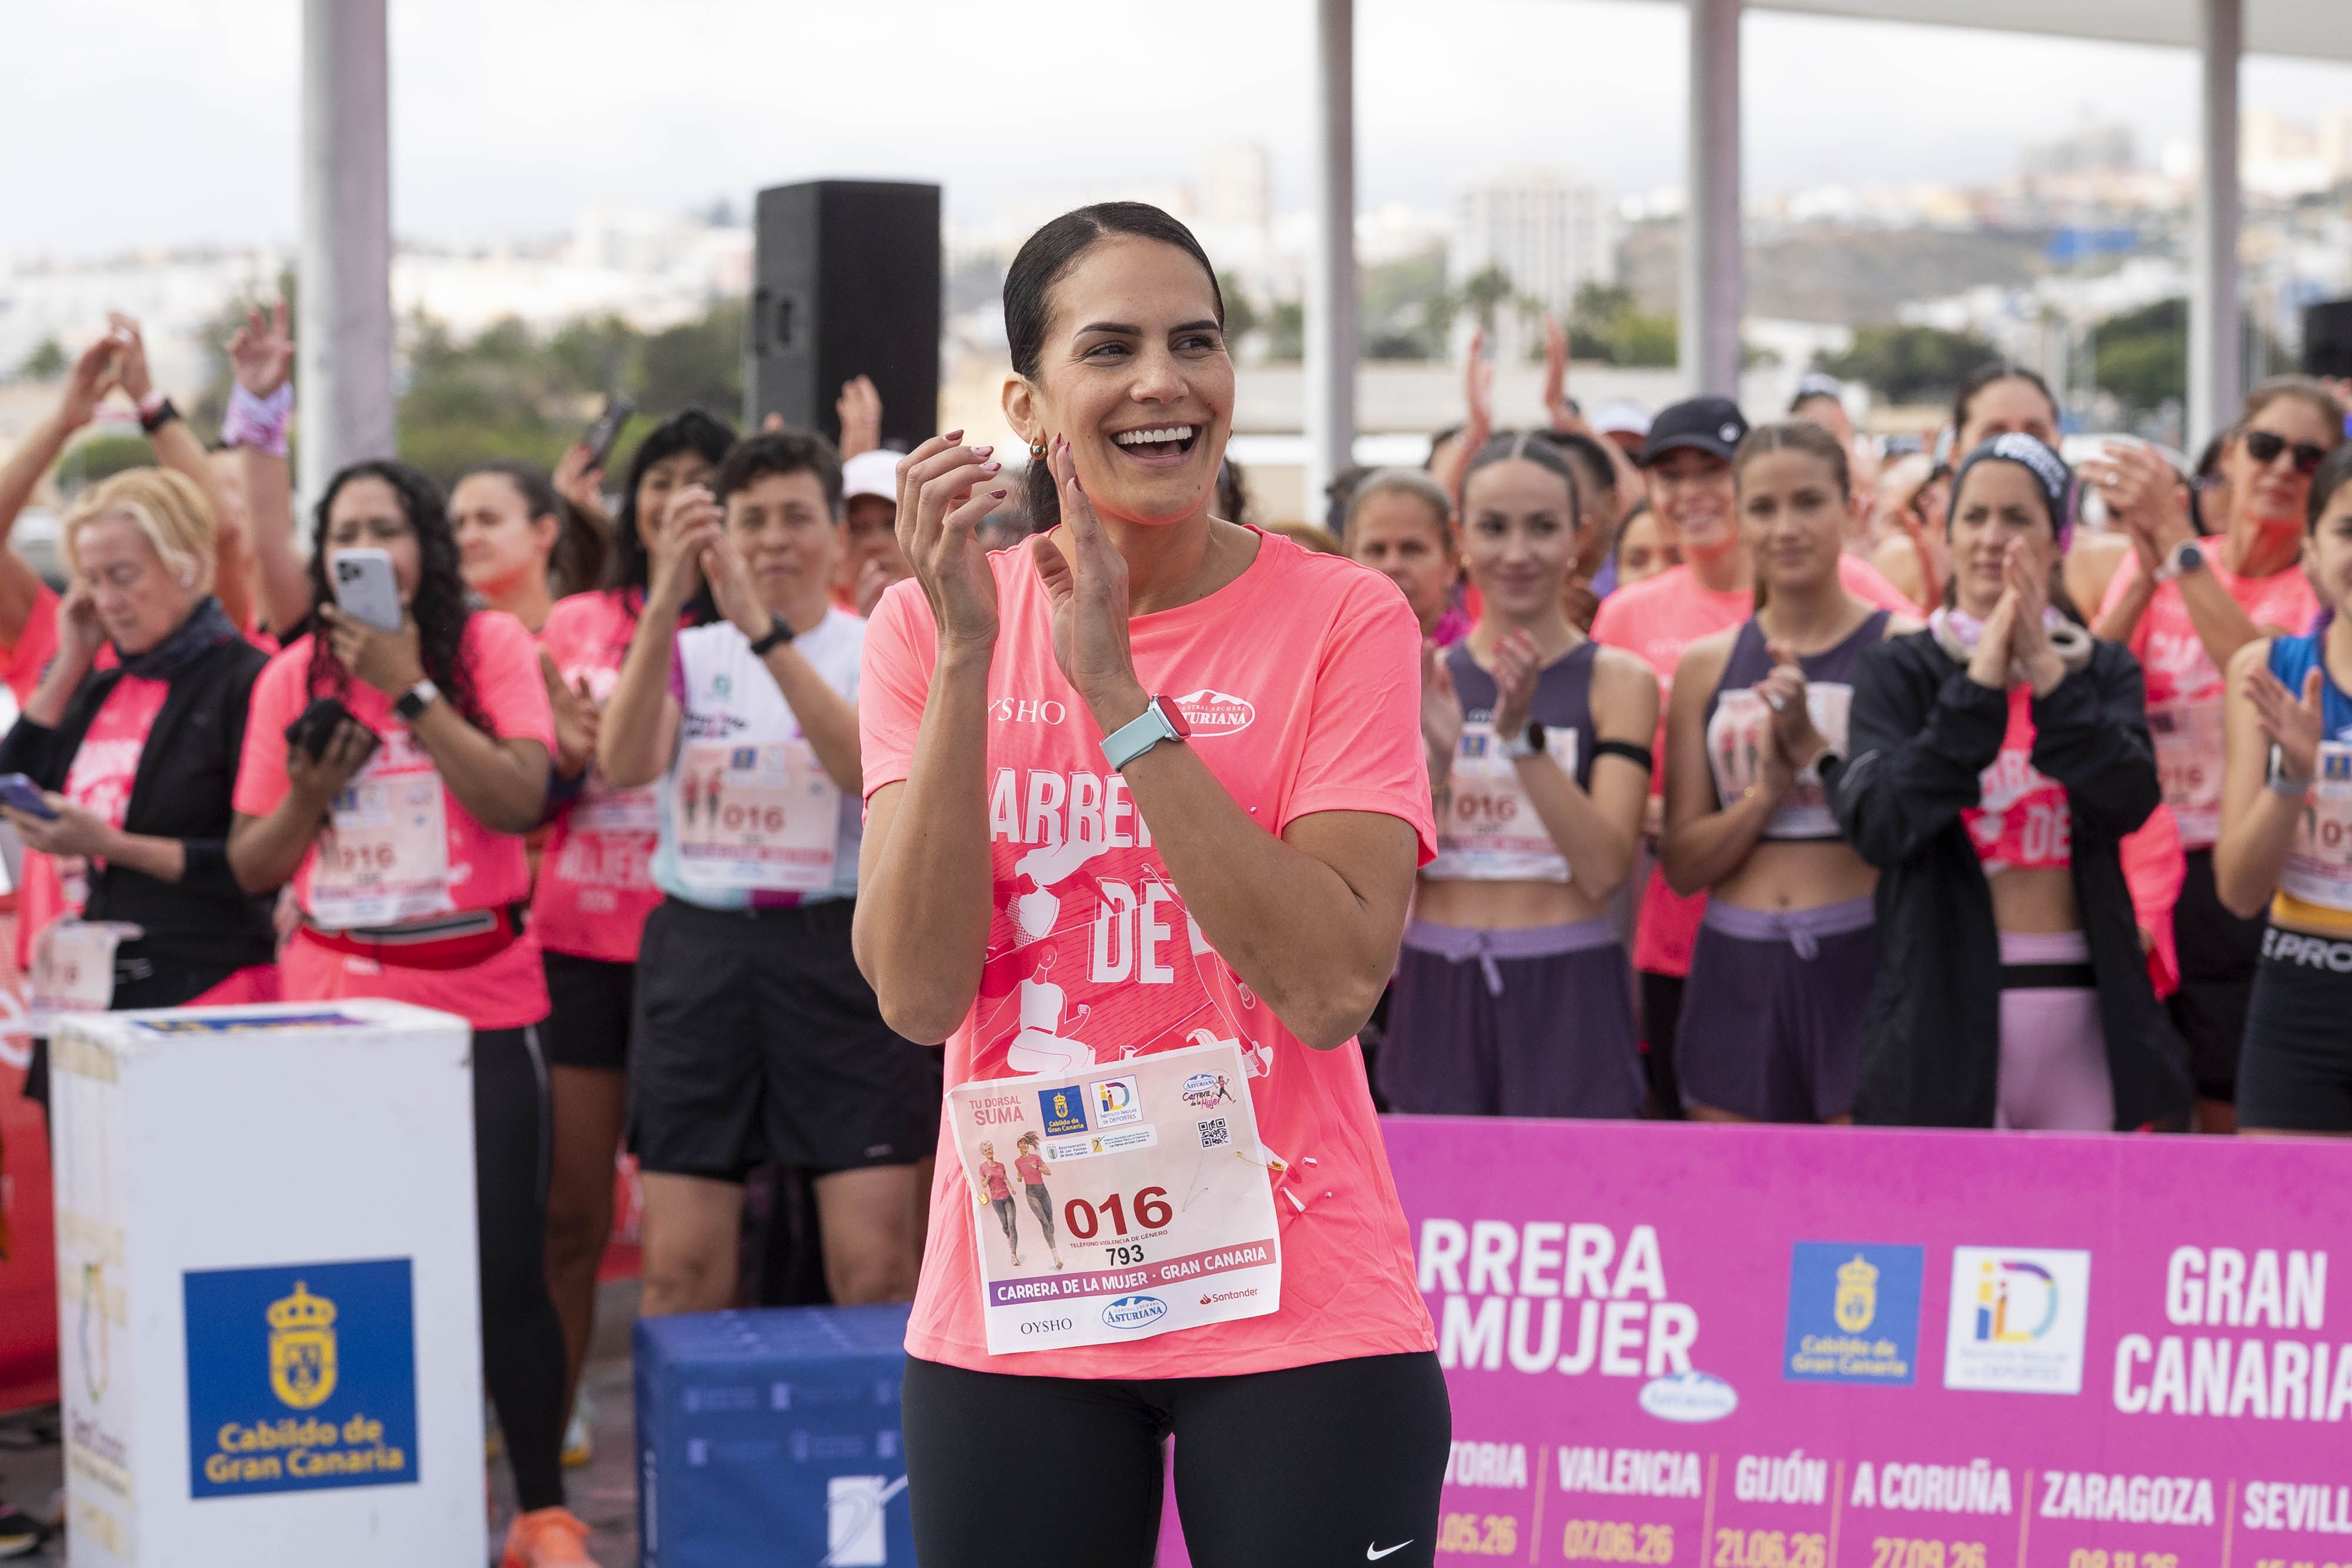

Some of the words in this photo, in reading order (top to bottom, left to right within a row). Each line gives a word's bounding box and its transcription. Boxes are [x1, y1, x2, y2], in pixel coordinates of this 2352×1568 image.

[1086, 877, 1175, 984] DE
[969, 1100, 982, 1109] TU
[985, 1096, 1021, 1108] DORSAL
[974, 1106, 1024, 1126] SUMA
[1109, 1114, 1136, 1123] DEPORTES
[1064, 1186, 1173, 1239] 016
[1099, 1238, 1130, 1246] VIOLENCIA
[1141, 1229, 1168, 1239] GÉNERO
[997, 1281, 1060, 1301] CARRERA
[1062, 1279, 1080, 1294] DE
[1083, 1276, 1101, 1292] LA
[1101, 1271, 1148, 1290] MUJER
[1160, 1259, 1201, 1281] GRAN
[1204, 1246, 1267, 1271] CANARIA
[1105, 1244, 1144, 1266] 793
[1418, 1218, 1667, 1301] RRERA
[1212, 1287, 1258, 1304] Santander
[2165, 1245, 2328, 1330] GRAN
[1021, 1318, 1073, 1335] OYSHO
[1107, 1306, 1163, 1323] ASTURIANA
[1440, 1295, 1699, 1378] MUJER
[2112, 1333, 2352, 1423] CANARIA
[217, 1416, 338, 1453] Cabildo
[342, 1412, 384, 1443] de
[205, 1453, 282, 1485] Gran
[286, 1441, 405, 1477] Canaria
[1558, 1445, 1701, 1499] VALENCIA
[1735, 1448, 1828, 1506] GIJÓN
[1850, 1461, 1876, 1509] A
[1881, 1458, 2013, 1514] CORUÑA
[2039, 1470, 2215, 1527] ZARAGOZA
